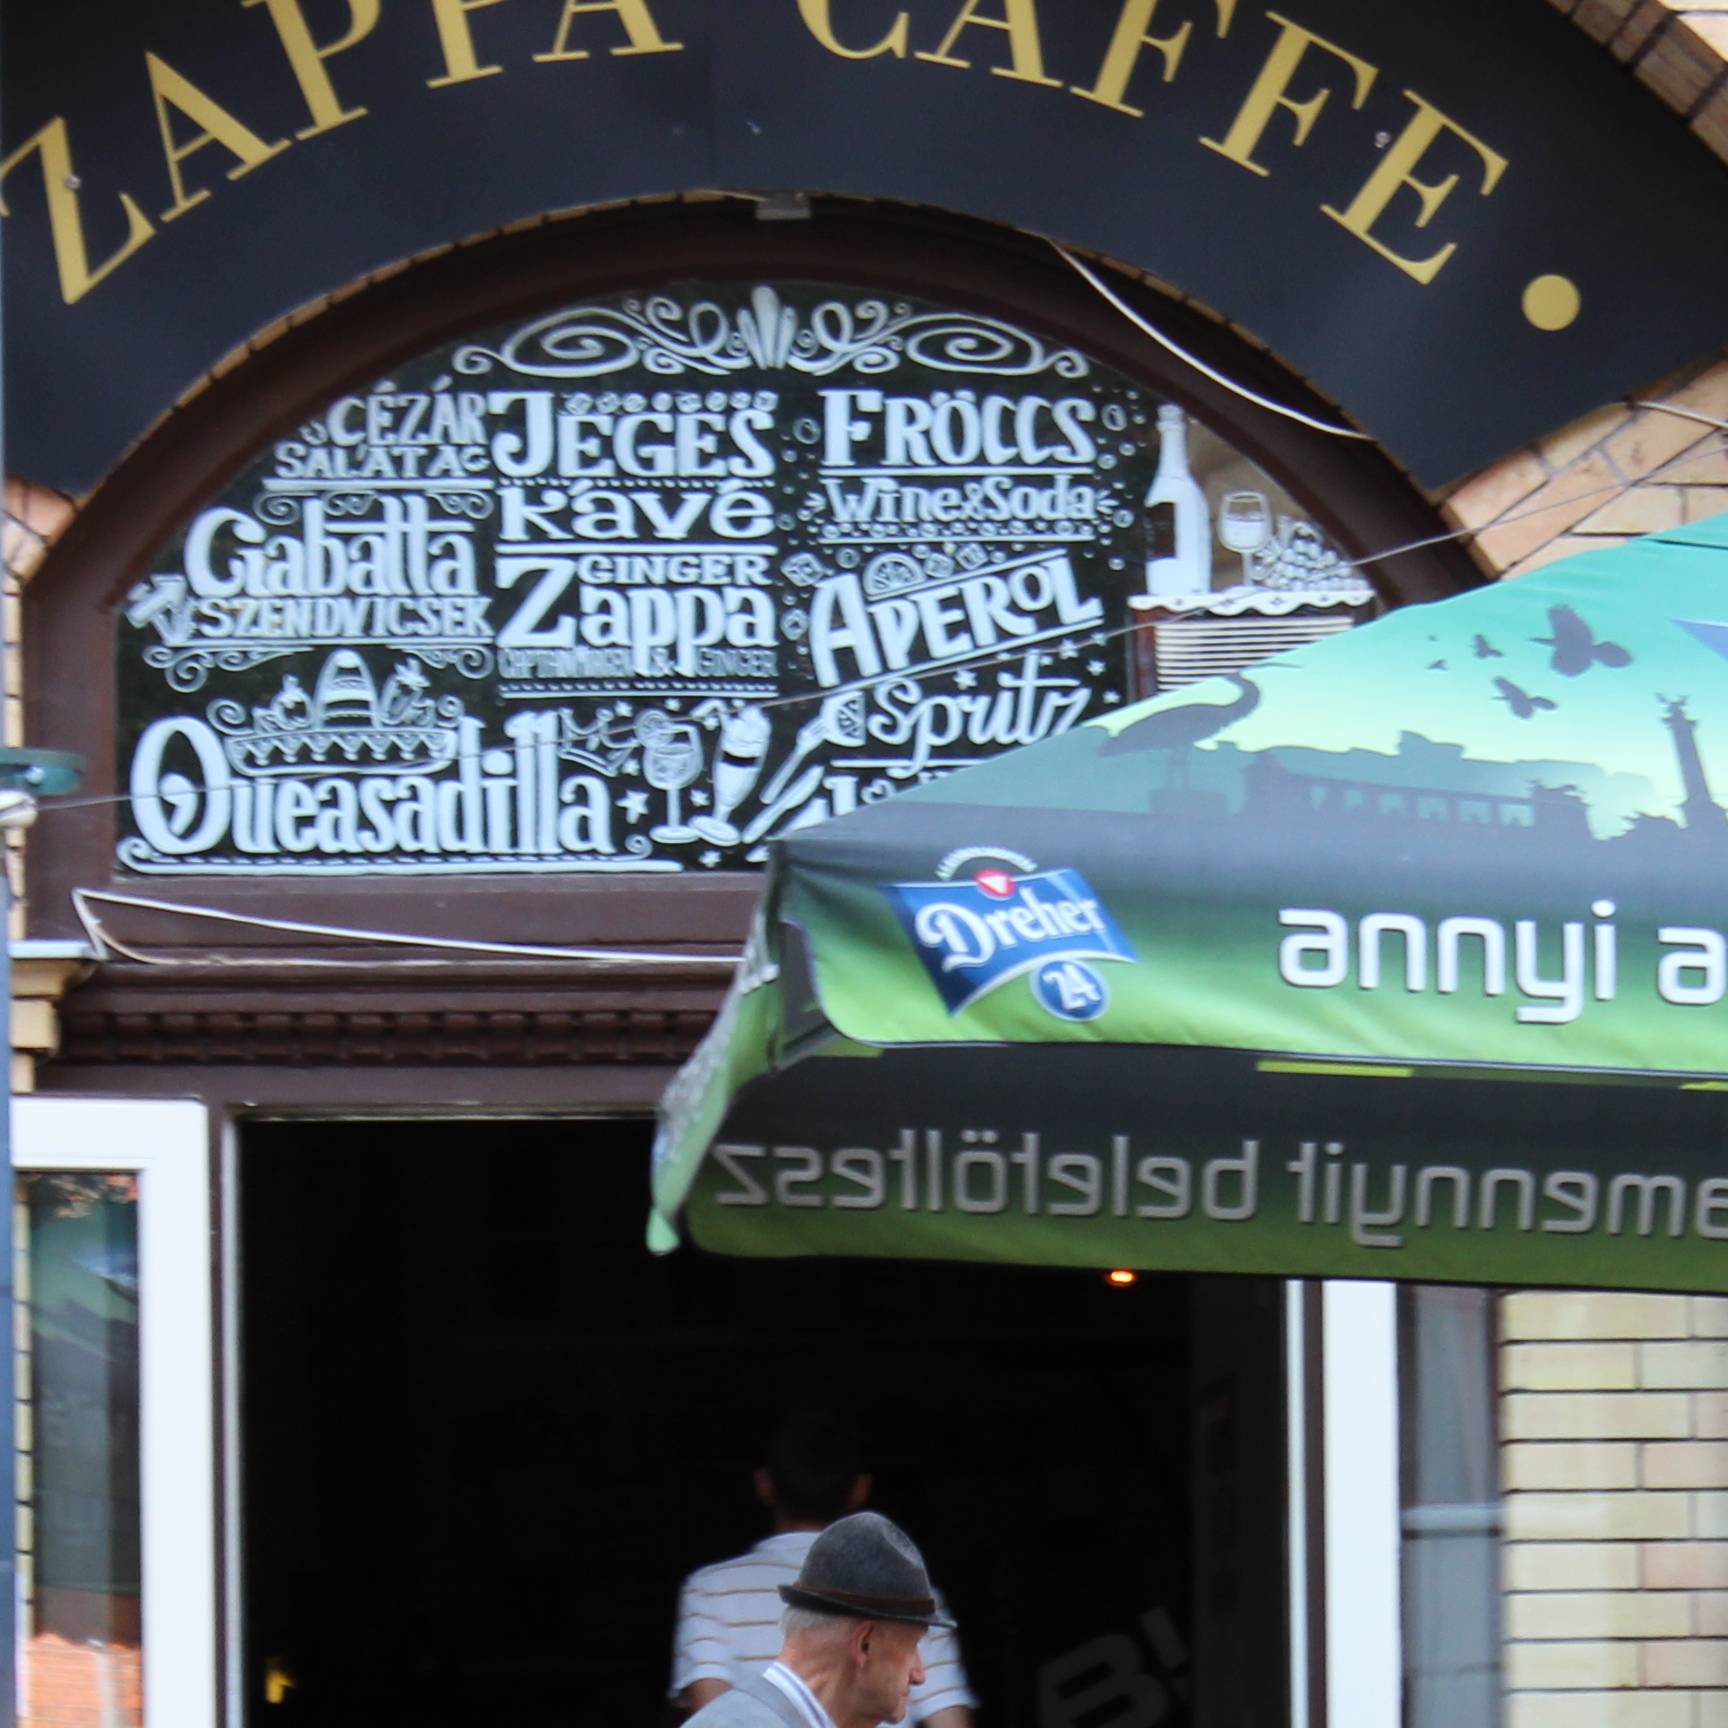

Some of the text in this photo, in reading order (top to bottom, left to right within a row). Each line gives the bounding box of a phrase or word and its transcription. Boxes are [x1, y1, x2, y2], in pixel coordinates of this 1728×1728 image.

[326, 376, 488, 446] CÉZÁR
[488, 391, 775, 477] JEGES
[818, 389, 1097, 467] FRÖCCS
[576, 554, 773, 585] GINGER
[495, 557, 780, 677] Zappa
[809, 556, 1105, 688] APEROL
[870, 649, 1093, 778] Spritz
[130, 711, 615, 854] Queasadilla
[914, 886, 1108, 973] Dreher
[1277, 899, 1618, 1025] annyi
[1656, 926, 1728, 1006] a
[1041, 963, 1104, 1011] 24
